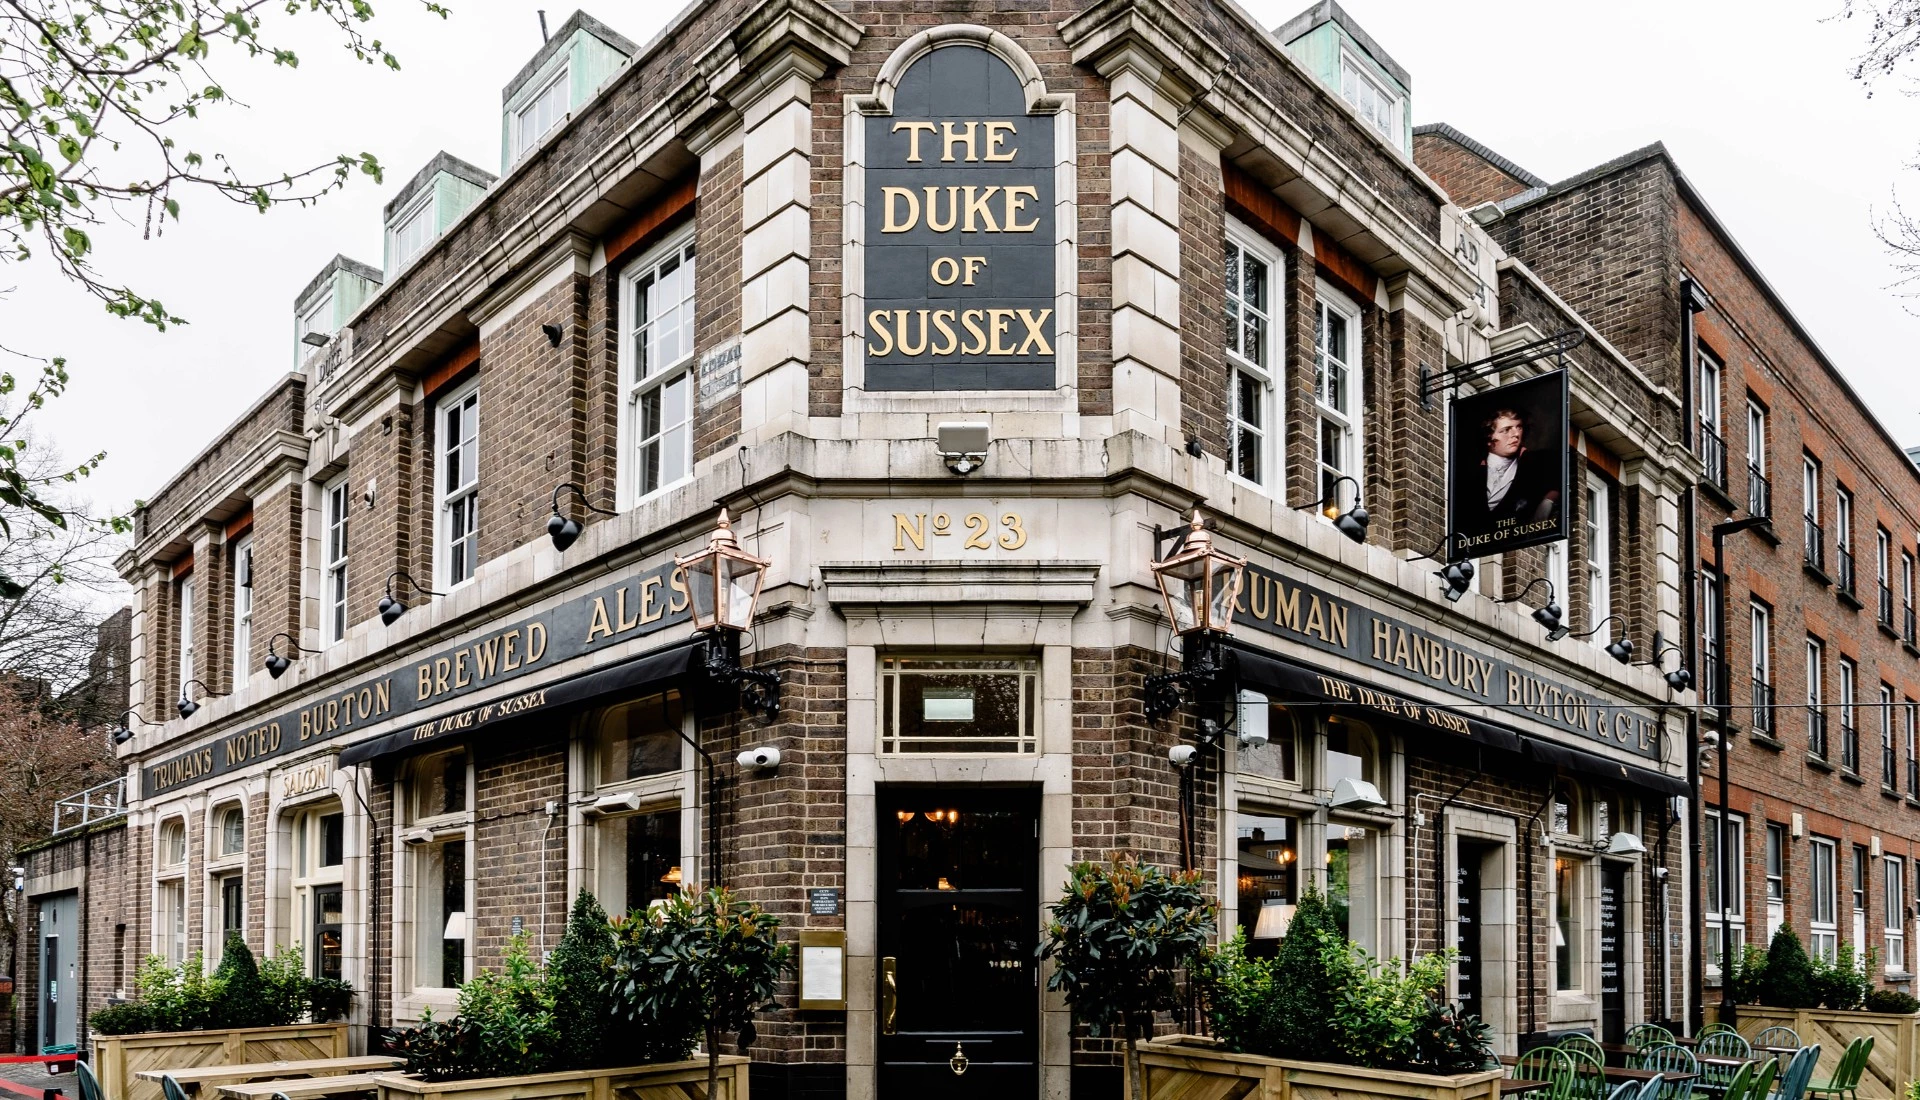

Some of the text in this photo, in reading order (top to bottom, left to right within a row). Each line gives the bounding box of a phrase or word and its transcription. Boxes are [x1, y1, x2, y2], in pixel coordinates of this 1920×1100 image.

[892, 121, 1018, 163] THE
[880, 185, 1040, 233] DUKE
[931, 256, 987, 286] OF
[868, 308, 1054, 357] SUSSEX
[964, 512, 1027, 551] 23
[1458, 518, 1557, 549] DUKE OF SUSSEX
[1496, 517, 1517, 528] THE
[225, 721, 281, 767] NOTED
[300, 679, 392, 741] BURTON
[417, 621, 549, 701] BREWED
[585, 566, 690, 643] ALES
[1222, 569, 1349, 649] RUMAN
[1371, 617, 1495, 697] HANBURY
[1506, 669, 1590, 731] BUXTON
[1597, 709, 1609, 738] &
[412, 688, 550, 741] THE DUKE OF SUSSEX
[1317, 675, 1472, 736] THE DUKE OF SUSSEX
[283, 764, 327, 797] SALOON
